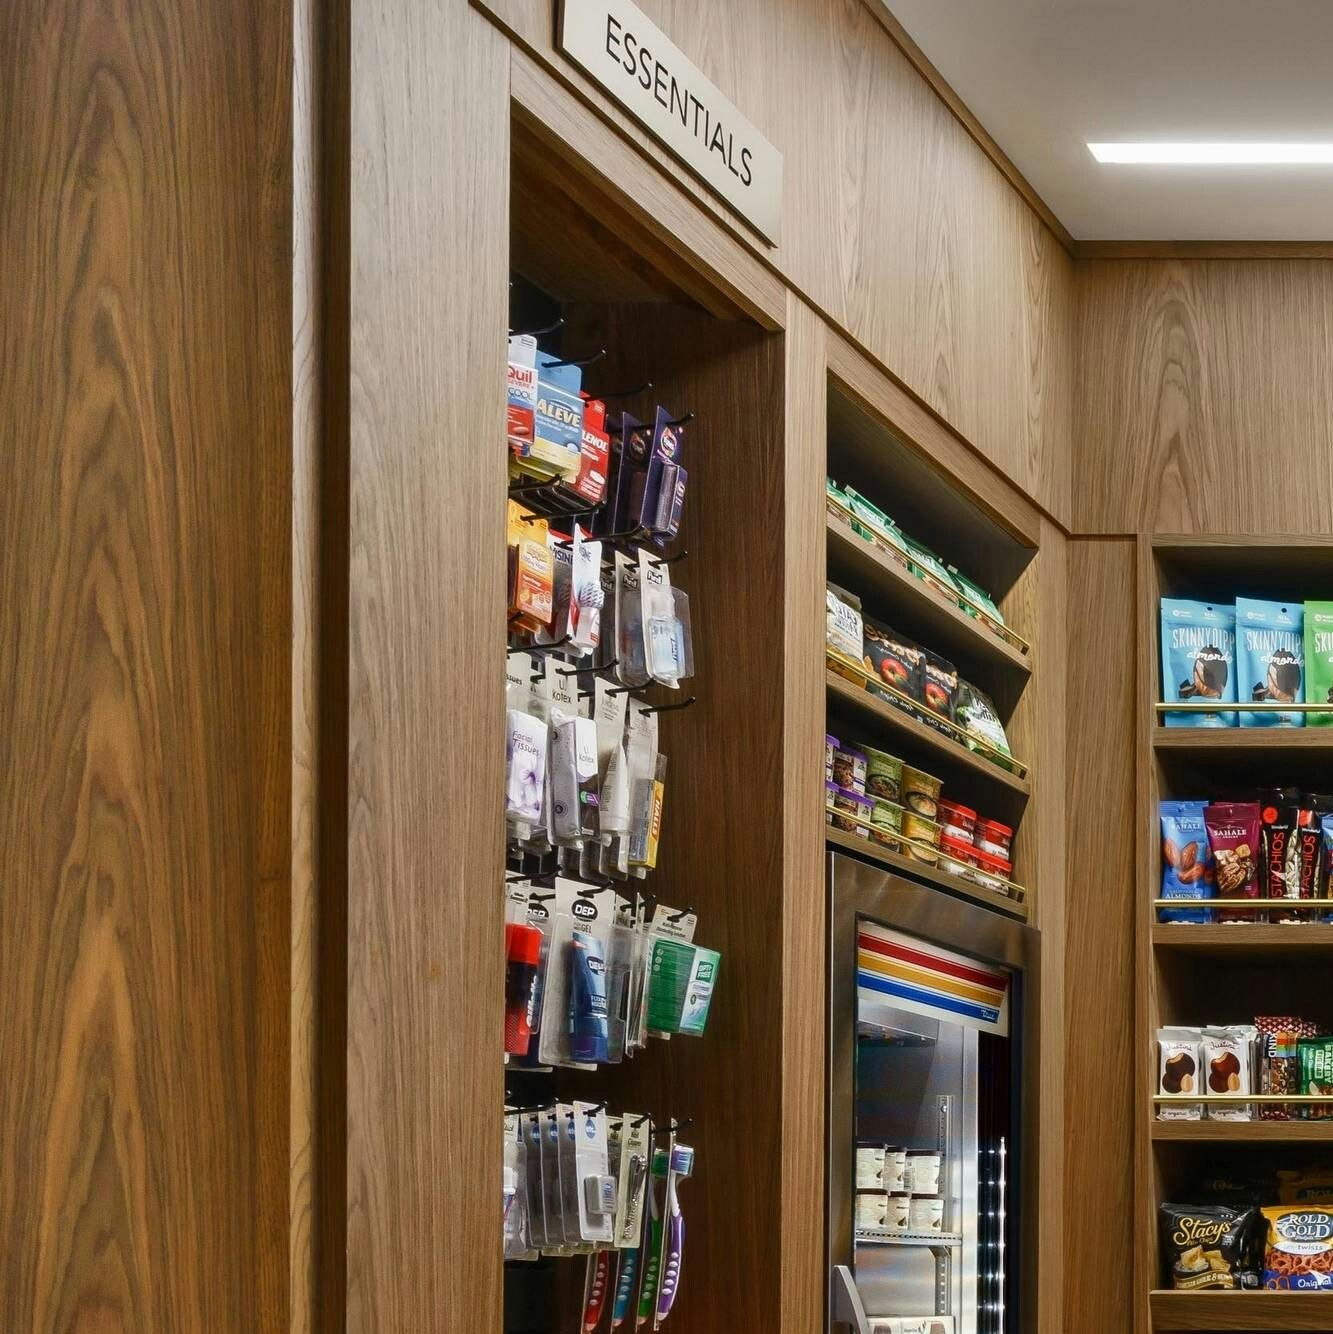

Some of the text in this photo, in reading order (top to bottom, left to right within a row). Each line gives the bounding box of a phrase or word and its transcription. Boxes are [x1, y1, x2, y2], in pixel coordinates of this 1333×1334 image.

[606, 14, 753, 187] ESSENTIALS
[536, 398, 580, 426] ALEVE
[1187, 648, 1232, 664] almonds
[512, 739, 540, 756] Tissues
[574, 904, 595, 916] DEP
[1268, 1032, 1277, 1058] KIND
[1324, 1044, 1332, 1083] BAKERY
[1288, 1214, 1330, 1224] ROLD
[1173, 1217, 1232, 1246] Stacy's
[1282, 1224, 1331, 1238] GOLD
